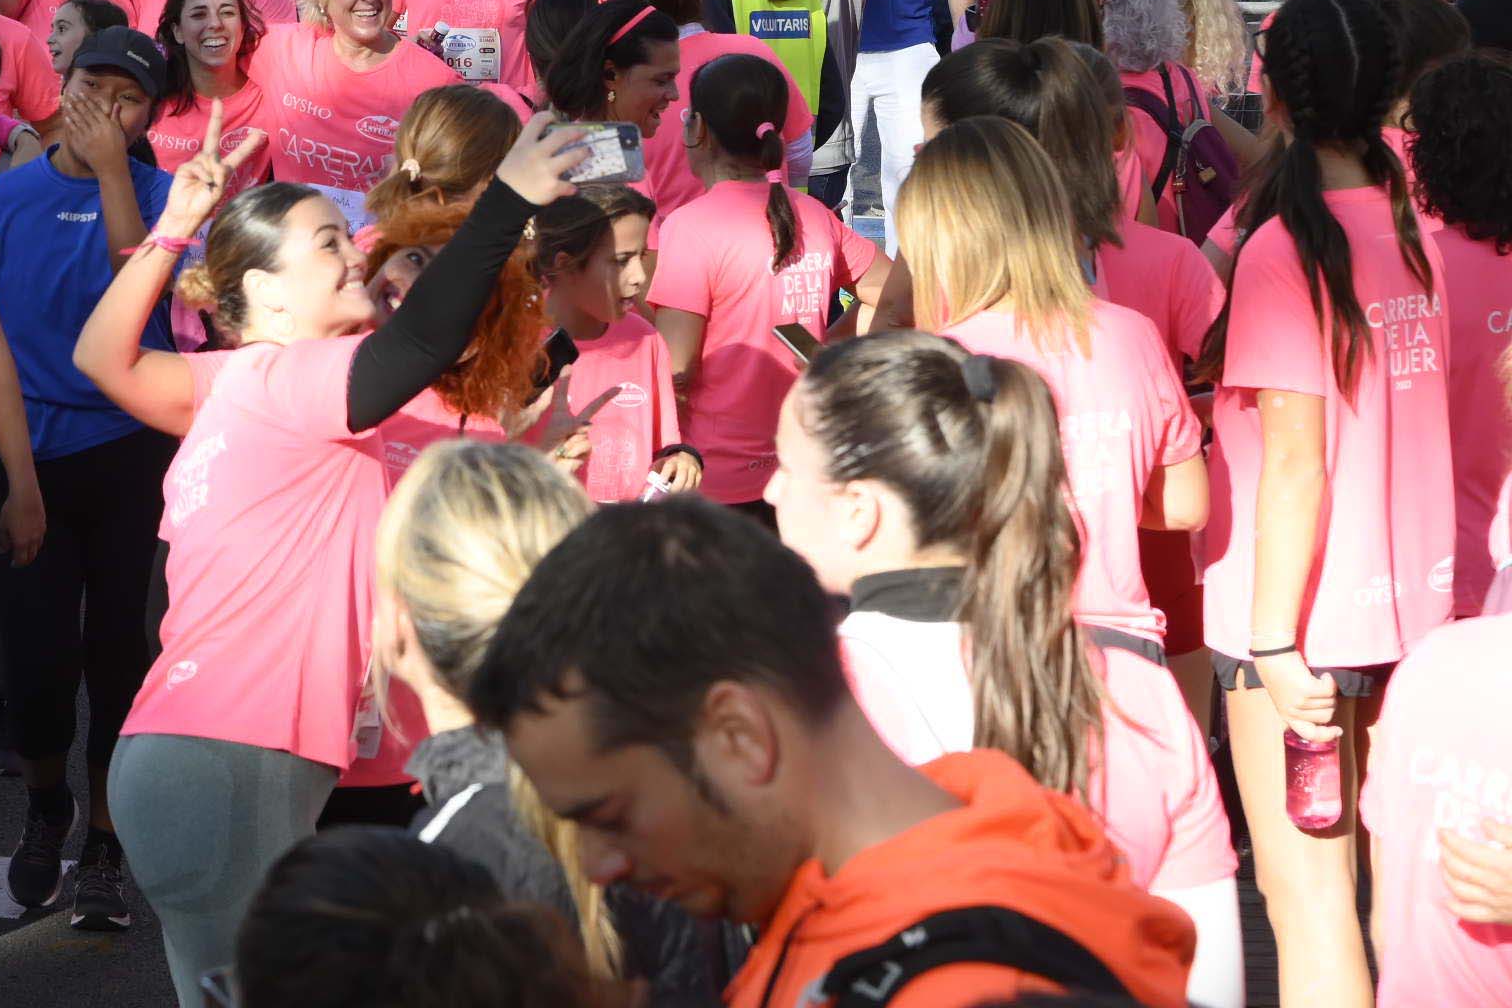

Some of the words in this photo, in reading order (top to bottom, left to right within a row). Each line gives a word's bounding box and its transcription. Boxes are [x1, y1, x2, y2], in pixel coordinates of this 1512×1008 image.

[446, 57, 472, 68] 016
[282, 92, 332, 120] OYSHO
[147, 129, 200, 153] OYSHO
[784, 275, 802, 295] DE
[805, 273, 822, 293] LA
[1405, 321, 1431, 348] LA
[1389, 347, 1438, 376] UJER
